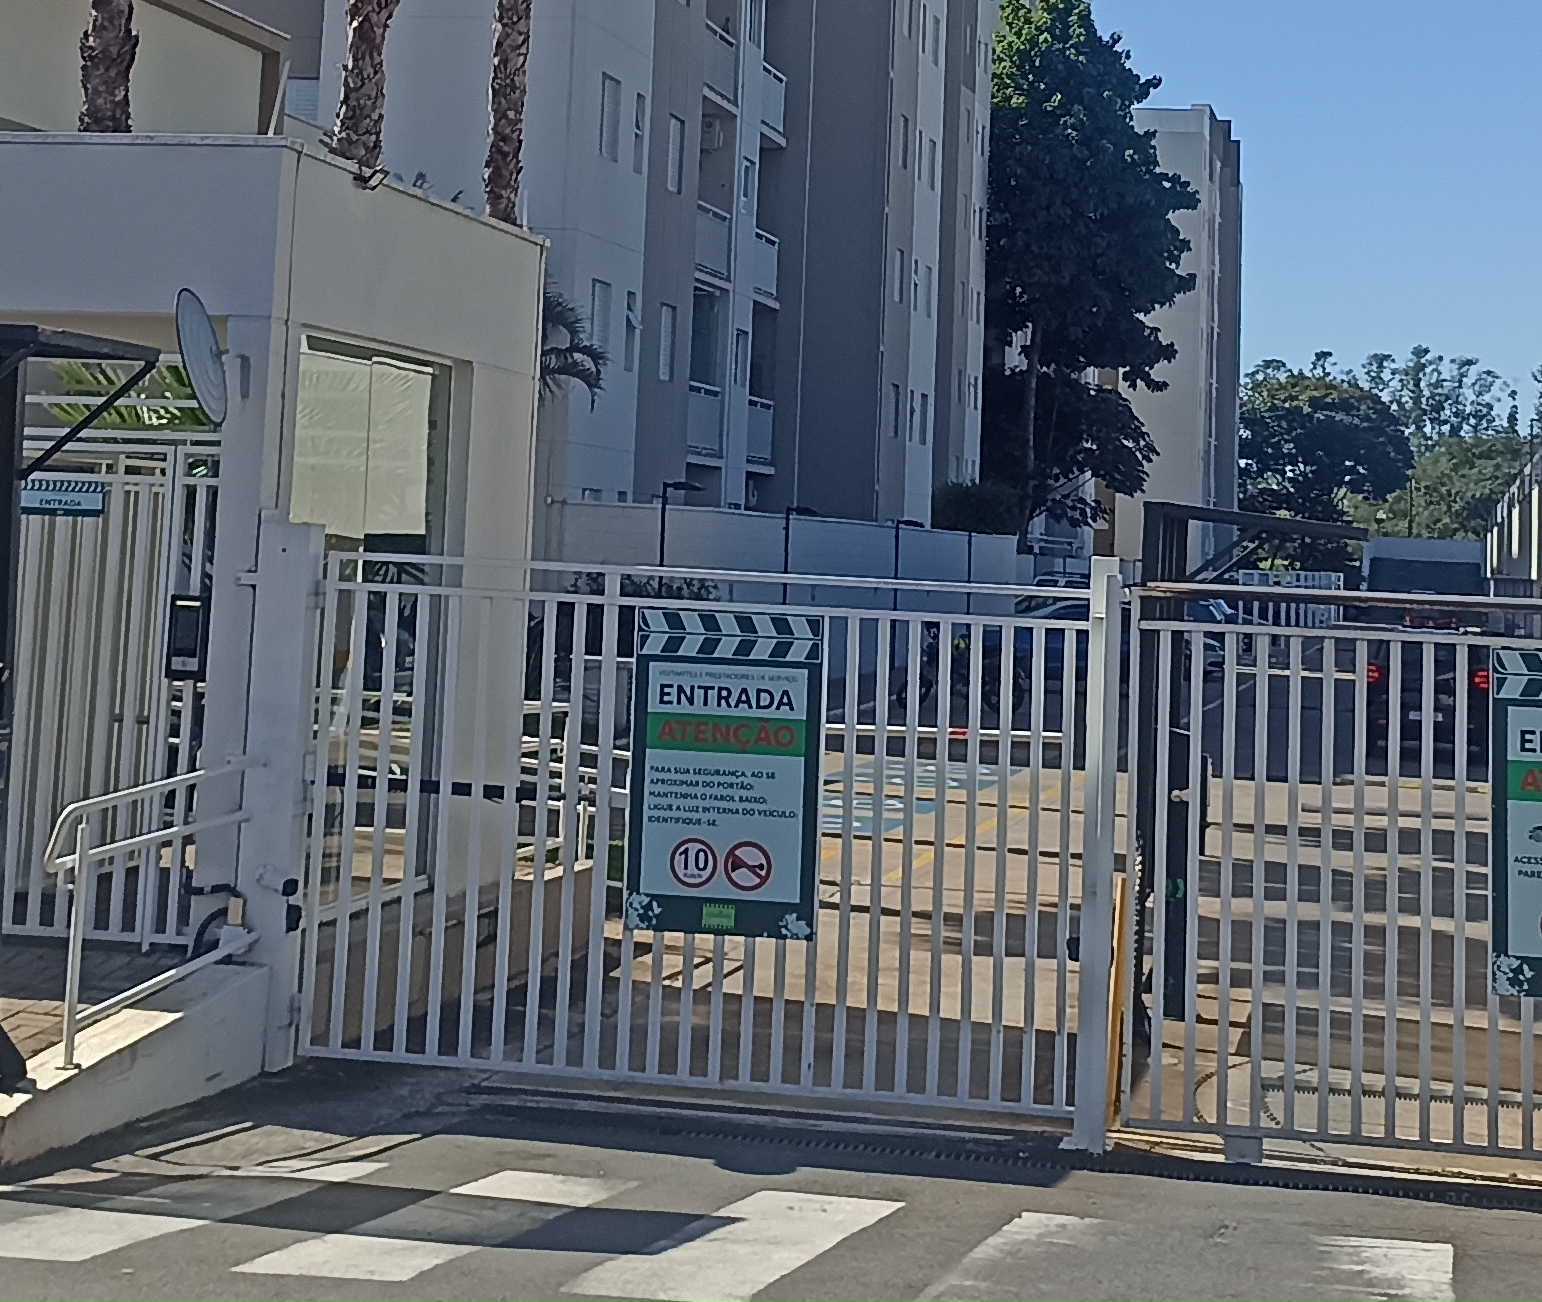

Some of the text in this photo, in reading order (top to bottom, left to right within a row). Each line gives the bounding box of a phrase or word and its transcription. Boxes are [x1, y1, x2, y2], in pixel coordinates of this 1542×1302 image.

[39, 498, 82, 506] ENTRADA
[659, 683, 795, 711] ENTRADA
[658, 718, 795, 752] ATENÇÃO
[649, 765, 672, 773] PARA
[674, 767, 690, 775] SUA
[751, 771, 763, 779] AO
[765, 771, 776, 780] SE
[650, 778, 699, 787] APROXIMAR
[702, 780, 715, 788] DO
[649, 791, 698, 800] MANTENHA
[709, 794, 736, 802] FAROL
[648, 803, 673, 811] LIGUE
[683, 805, 699, 813] LUZ
[702, 806, 739, 816] INTERNA
[742, 808, 755, 816] DO
[678, 846, 709, 872] 10
[1517, 869, 1542, 879] PARE
